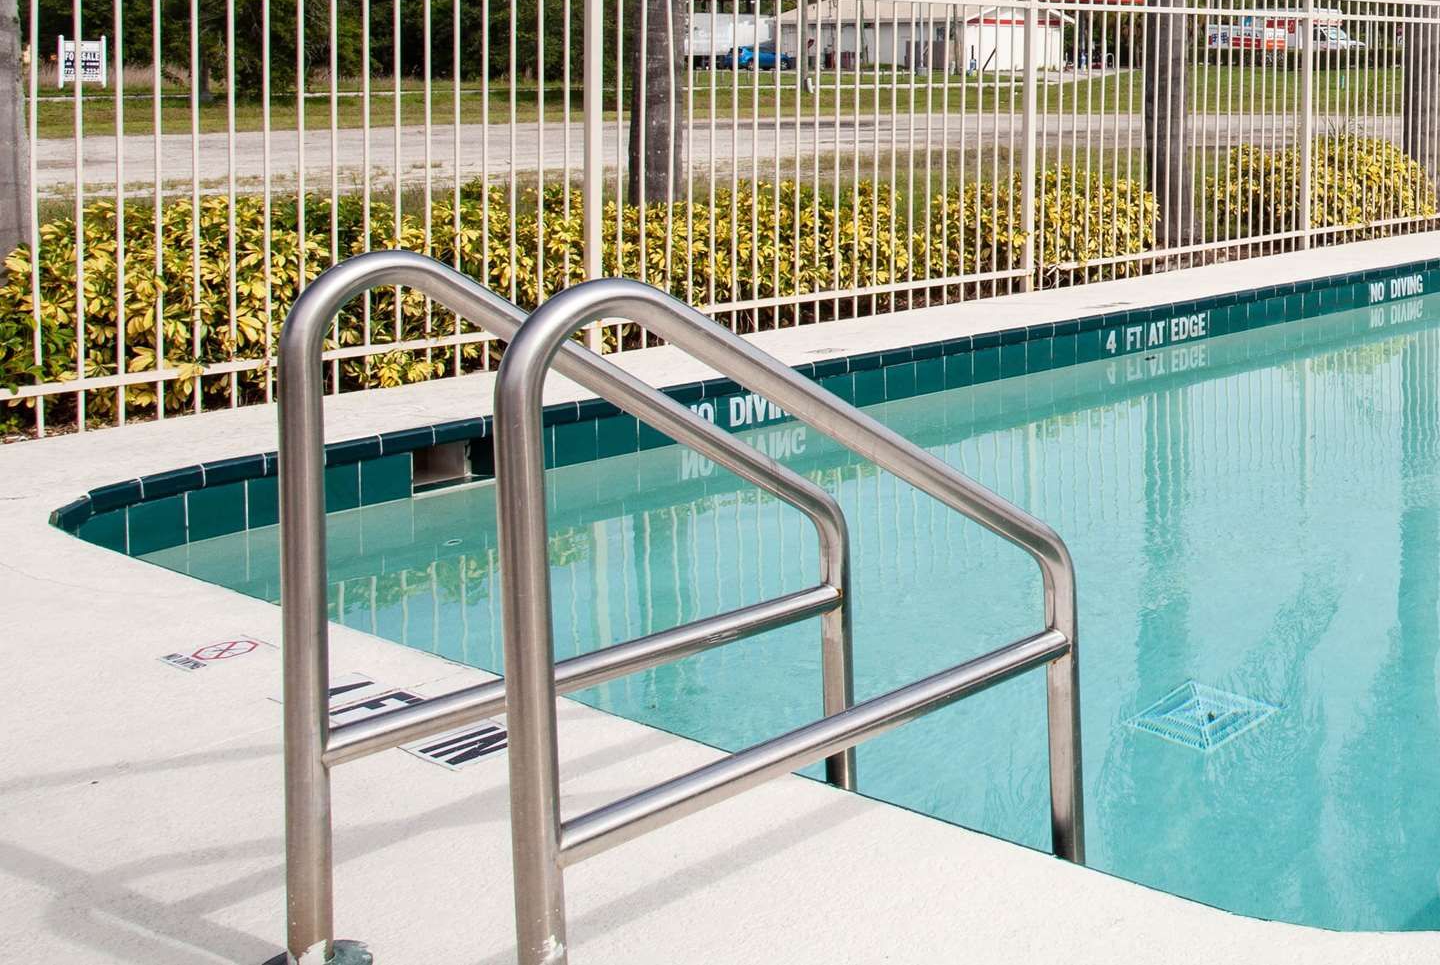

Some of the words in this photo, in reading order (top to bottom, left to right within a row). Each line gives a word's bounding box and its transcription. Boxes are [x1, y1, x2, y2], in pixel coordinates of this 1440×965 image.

[81, 52, 100, 61] SALE
[1370, 282, 1385, 304] NO
[1390, 273, 1424, 300] DIVING
[1106, 330, 1117, 354] 4
[1126, 326, 1142, 351] FT
[1148, 321, 1165, 347] AT
[1171, 312, 1206, 342] EDGE
[729, 394, 791, 427] DIVI
